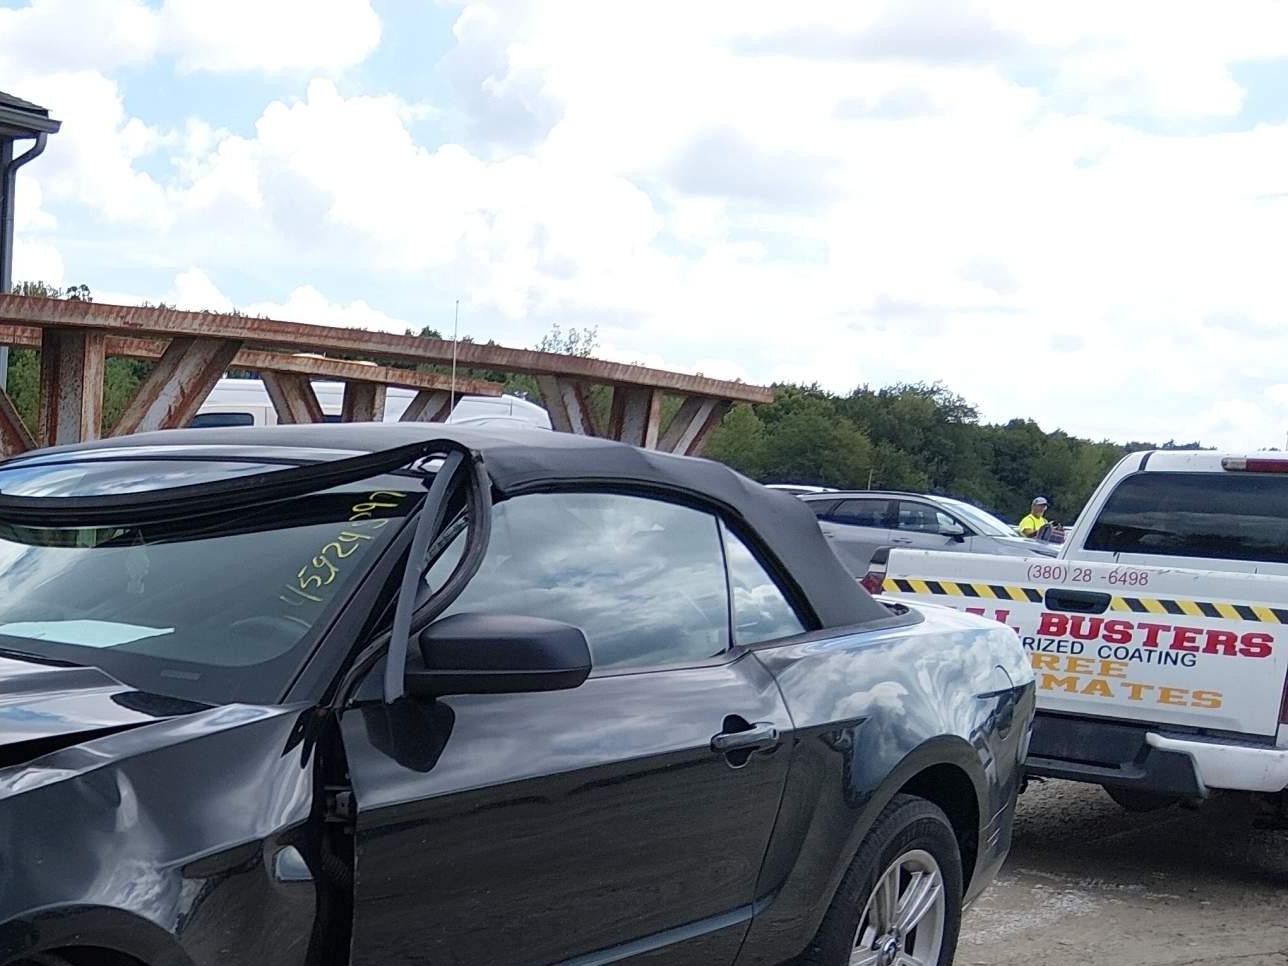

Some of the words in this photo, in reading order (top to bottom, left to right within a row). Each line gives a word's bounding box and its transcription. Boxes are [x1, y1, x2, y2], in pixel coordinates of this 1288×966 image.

[1027, 564, 1068, 584] (380)
[1037, 612, 1274, 658] BUSTERS
[1022, 636, 1084, 655] RIZED
[1097, 644, 1197, 667] COATING
[1030, 652, 1129, 679] REE
[1038, 673, 1223, 709] MATES
